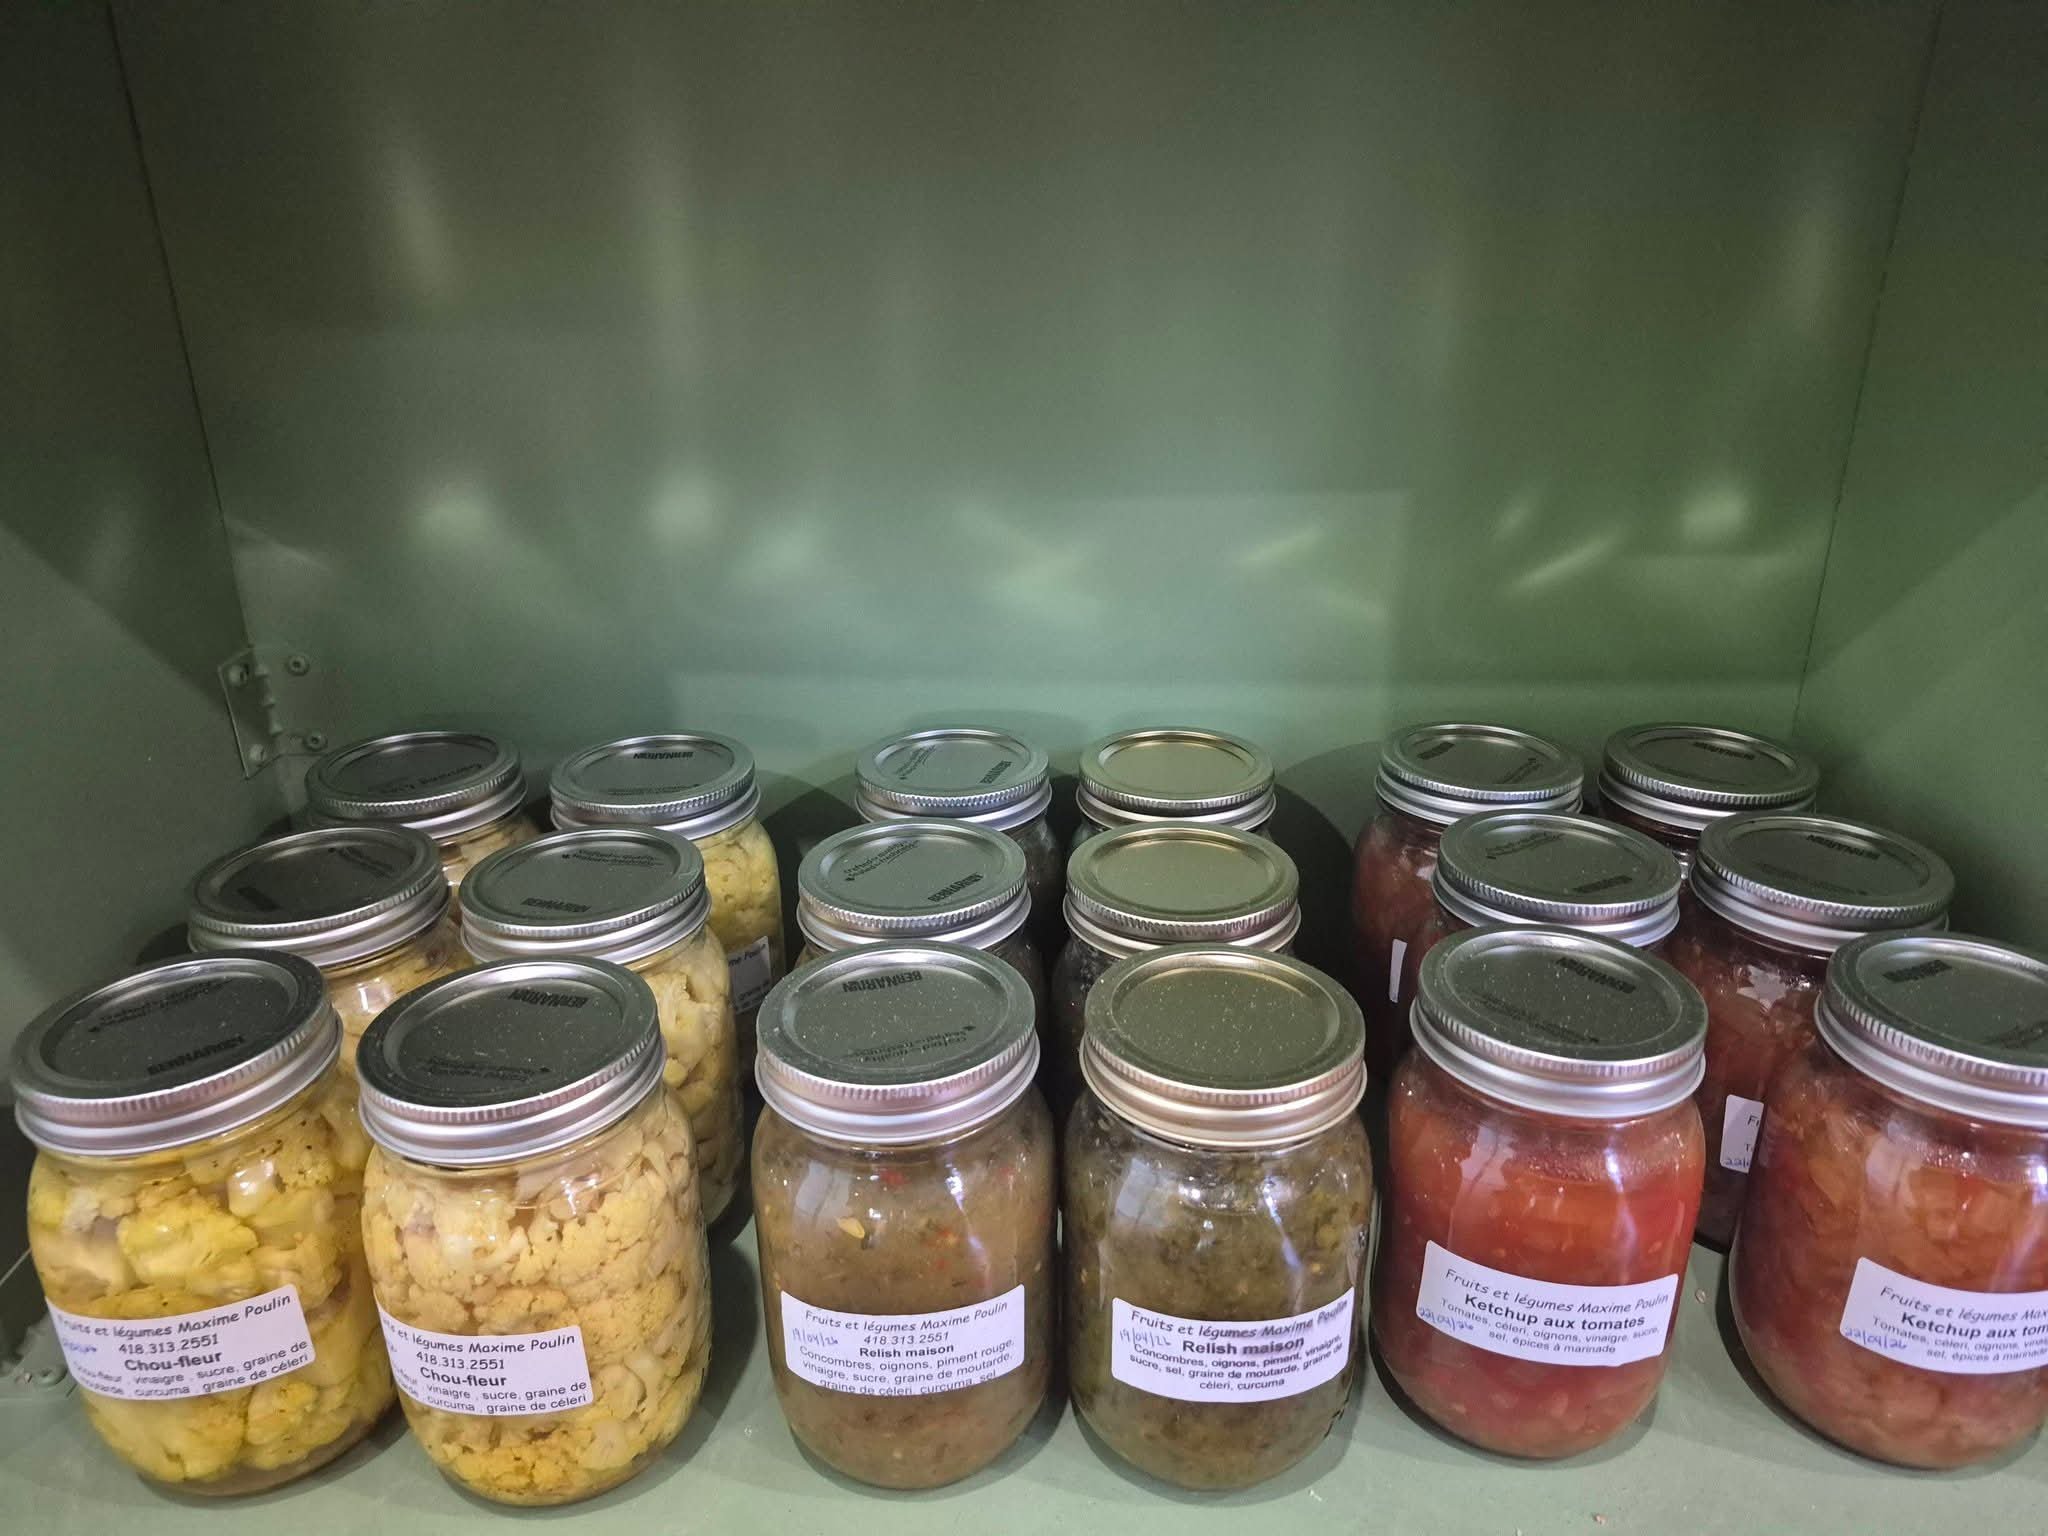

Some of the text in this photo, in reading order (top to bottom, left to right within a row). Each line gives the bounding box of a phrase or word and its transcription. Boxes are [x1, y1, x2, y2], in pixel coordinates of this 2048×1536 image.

[1445, 1268, 1669, 1314] Fruits et légumes Maxime Poulin
[94, 1326, 108, 1337] et
[113, 1325, 172, 1341] légumes
[178, 1312, 240, 1334] Maxime
[245, 1294, 291, 1317] Poulin
[805, 1301, 1008, 1334] Fruits et légumes Maxime Poulin
[1441, 1298, 1491, 1326] Tomates,
[1464, 1293, 1645, 1331] Ketchup aux tomates
[1880, 1286, 1931, 1312] Fruits
[1935, 1307, 1953, 1318] et
[1958, 1307, 2018, 1324] légumes
[1131, 1310, 1173, 1332] Fruits
[1178, 1325, 1194, 1336] et
[1199, 1325, 1257, 1340] légumes
[1260, 1318, 1313, 1338] Maxime
[1872, 1315, 1930, 1344] Tomates,
[1901, 1312, 1981, 1340] Ketchup
[1986, 1326, 2016, 1339] aux
[118, 1333, 219, 1355] 418.313.2551
[413, 1333, 464, 1353] légumes
[469, 1342, 525, 1353] Maxime
[531, 1335, 575, 1351] Poulin
[863, 1331, 950, 1345] 418.313.2551
[1182, 1337, 1304, 1356] Relish maison
[1512, 1334, 1550, 1351] épices
[1553, 1340, 1560, 1352] à
[1564, 1344, 1616, 1354] marinade
[124, 1350, 222, 1372] Chou-fleur
[243, 1351, 286, 1372] graine
[290, 1339, 308, 1355] de
[416, 1351, 505, 1370] 418.313.2551
[799, 1345, 876, 1370] Concombres,
[937, 1351, 978, 1368] piment
[859, 1344, 954, 1358] Relish maison
[1134, 1343, 1208, 1368] Concombres,
[1952, 1352, 1989, 1363] épices
[1992, 1352, 2000, 1361] à
[202, 1376, 245, 1393] graine
[249, 1369, 267, 1382] de
[271, 1354, 309, 1375] céleri
[420, 1367, 507, 1387] Chou-fleur
[853, 1372, 890, 1385] sucre,
[894, 1371, 938, 1386] graine
[940, 1369, 953, 1380] de
[1129, 1354, 1161, 1372] sucre,
[1165, 1364, 1184, 1377] sel,
[1189, 1369, 1224, 1381] graine
[1228, 1369, 1242, 1379] de
[1245, 1364, 1300, 1379] moutarde,
[1303, 1353, 1331, 1371] graine
[427, 1384, 471, 1399] vinaigre
[525, 1387, 566, 1402] graine
[570, 1381, 587, 1392] de
[820, 1378, 858, 1393] graine
[860, 1384, 875, 1395] de
[979, 1370, 997, 1382] sel
[1199, 1379, 1285, 1391] céleri, curcuma
[486, 1403, 526, 1415] graine
[530, 1402, 546, 1411] de
[550, 1395, 587, 1409] céleri
